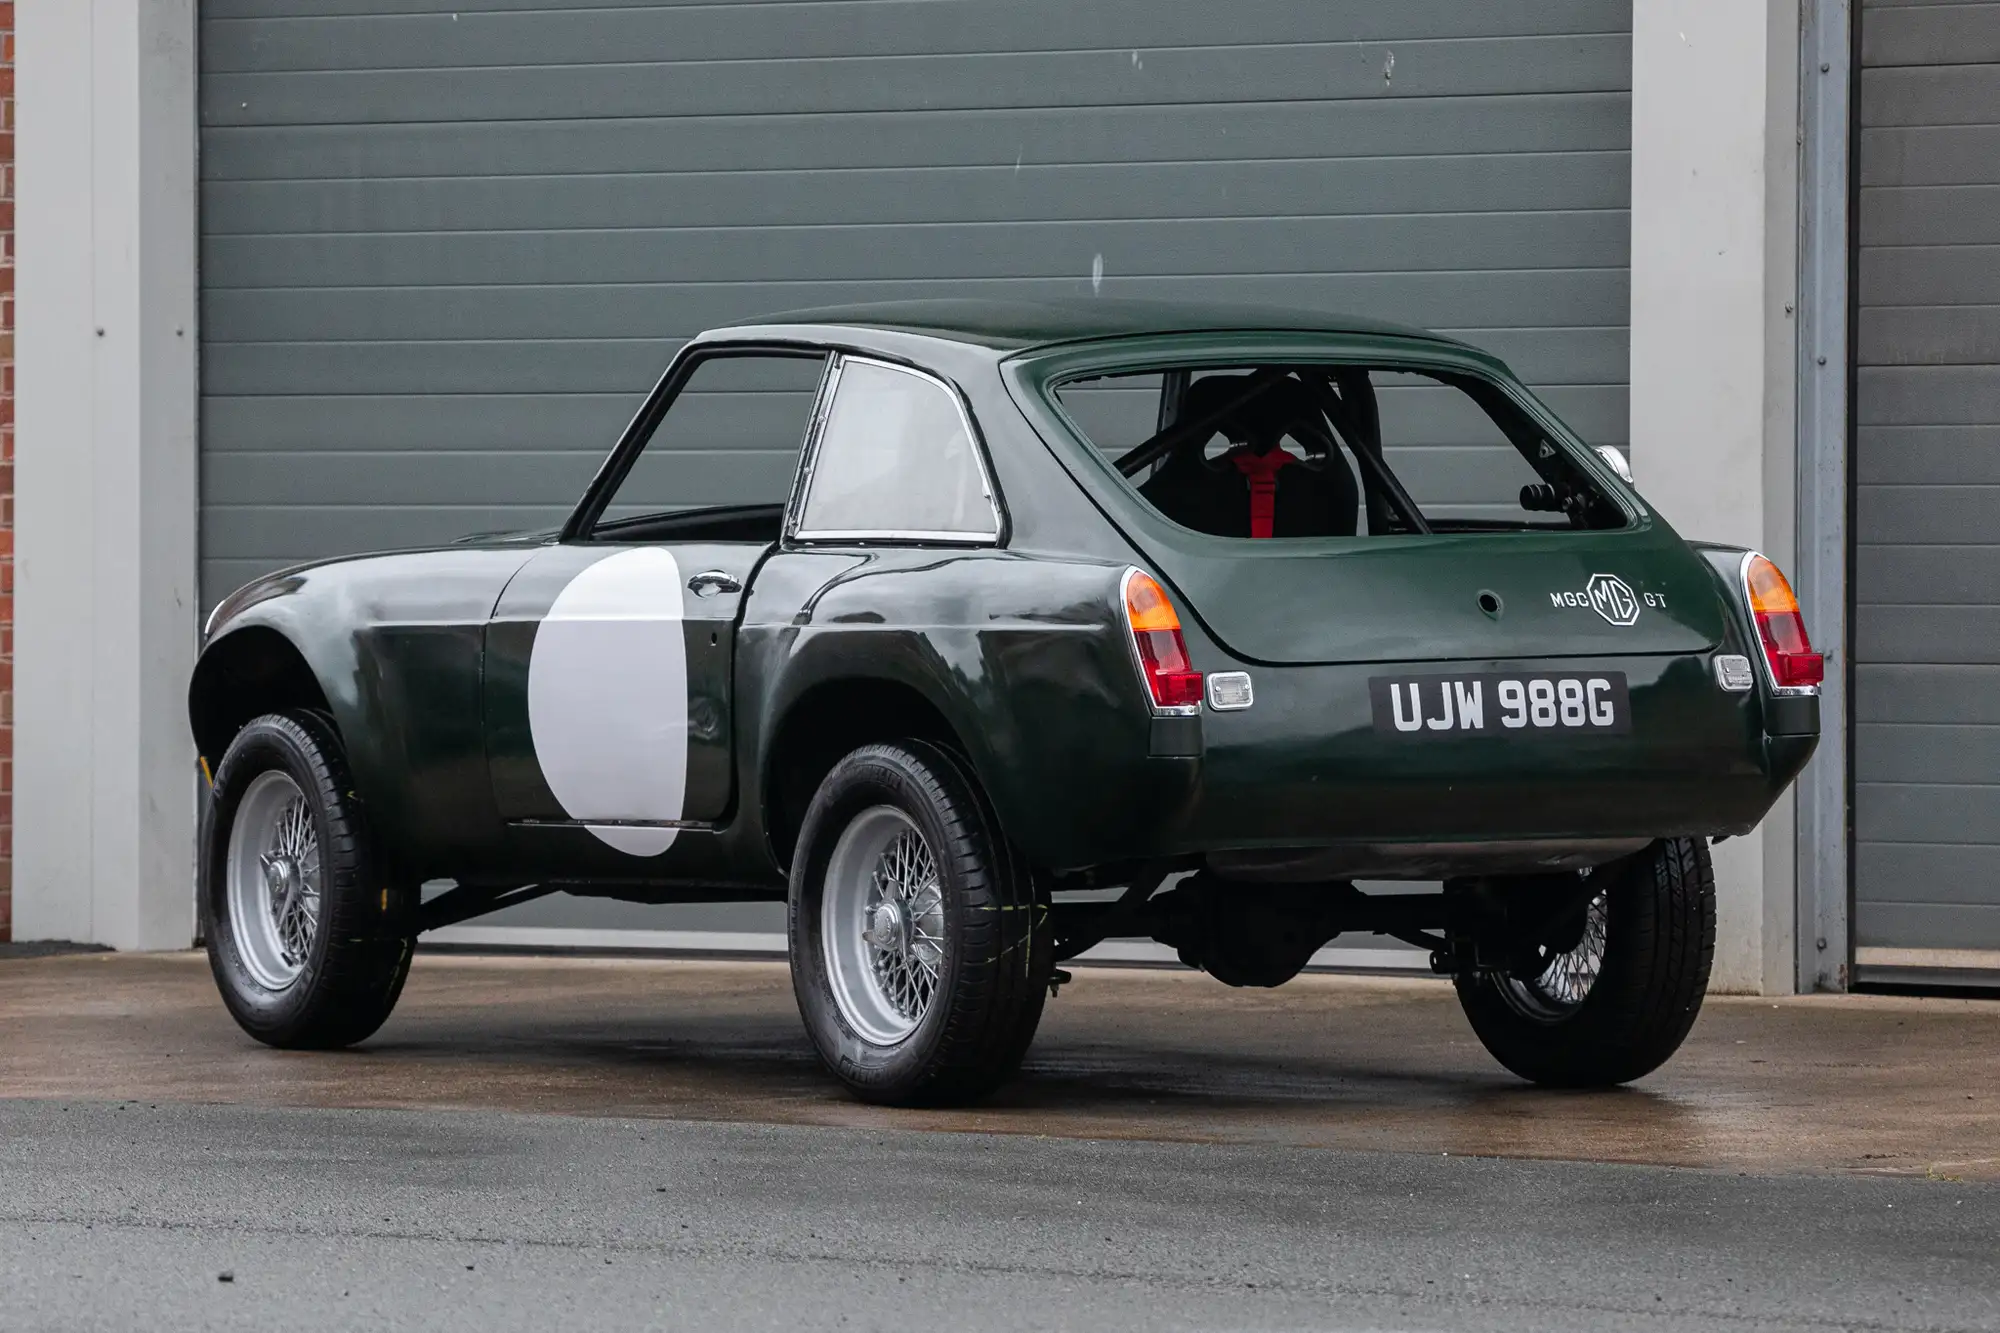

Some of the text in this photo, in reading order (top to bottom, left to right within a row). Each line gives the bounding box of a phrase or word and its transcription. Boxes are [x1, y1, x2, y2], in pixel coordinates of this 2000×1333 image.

[1549, 579, 1667, 619] MGC MG GT
[1390, 678, 1615, 732] UJW 988G
